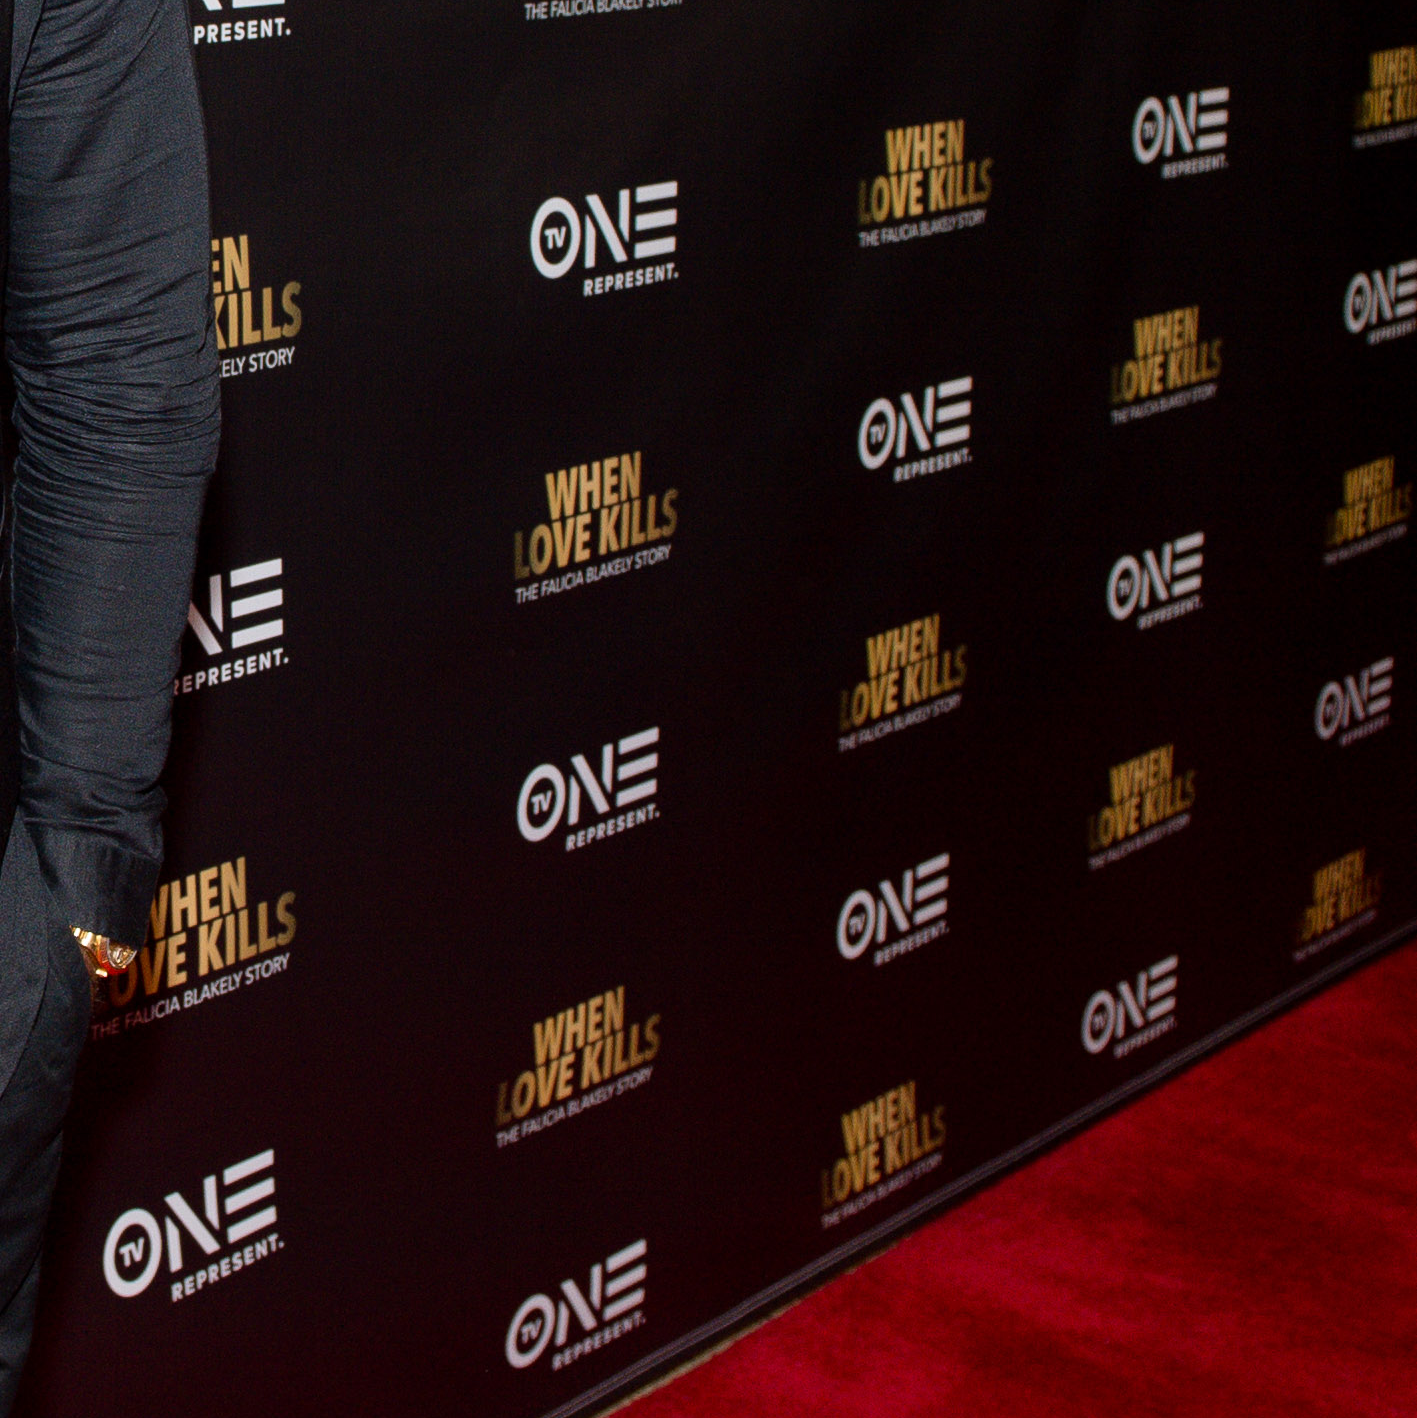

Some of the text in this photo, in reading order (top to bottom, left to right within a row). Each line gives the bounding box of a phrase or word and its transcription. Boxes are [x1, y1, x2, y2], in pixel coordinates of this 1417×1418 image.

[193, 17, 292, 44] PRESENT.
[525, 2, 548, 19] THE
[886, 119, 963, 173] WHEN
[1134, 87, 1228, 161] ONE
[531, 181, 677, 278] ONE
[858, 158, 993, 225] LOVE KILLS
[585, 263, 677, 296] REPRESENT.
[249, 346, 295, 373] STORY
[859, 376, 972, 468] ONE
[547, 450, 641, 520] WHEN
[514, 489, 678, 580] LOVE KILLS
[187, 558, 284, 656] NE
[1109, 532, 1203, 618] ONE
[869, 613, 941, 678] WHEN
[839, 670, 900, 731] LOVE
[905, 644, 969, 706] KILLS
[518, 727, 659, 841] ONE
[568, 804, 658, 851] REPRESENT.
[198, 891, 297, 977] KILLS
[838, 853, 948, 958] ONE
[125, 995, 182, 1028] FALICIA
[183, 971, 244, 1010] BLAKELY
[245, 952, 291, 985] STORY
[534, 987, 625, 1065] WHEN
[1084, 955, 1177, 1052] ONE
[497, 1015, 661, 1127] LOVE KILLS
[104, 1149, 276, 1297] ONE
[120, 1237, 143, 1266] TV
[172, 1234, 283, 1301] REPRESENT.
[508, 1239, 648, 1368] ONE
[555, 1311, 645, 1371] REPRESENT.
